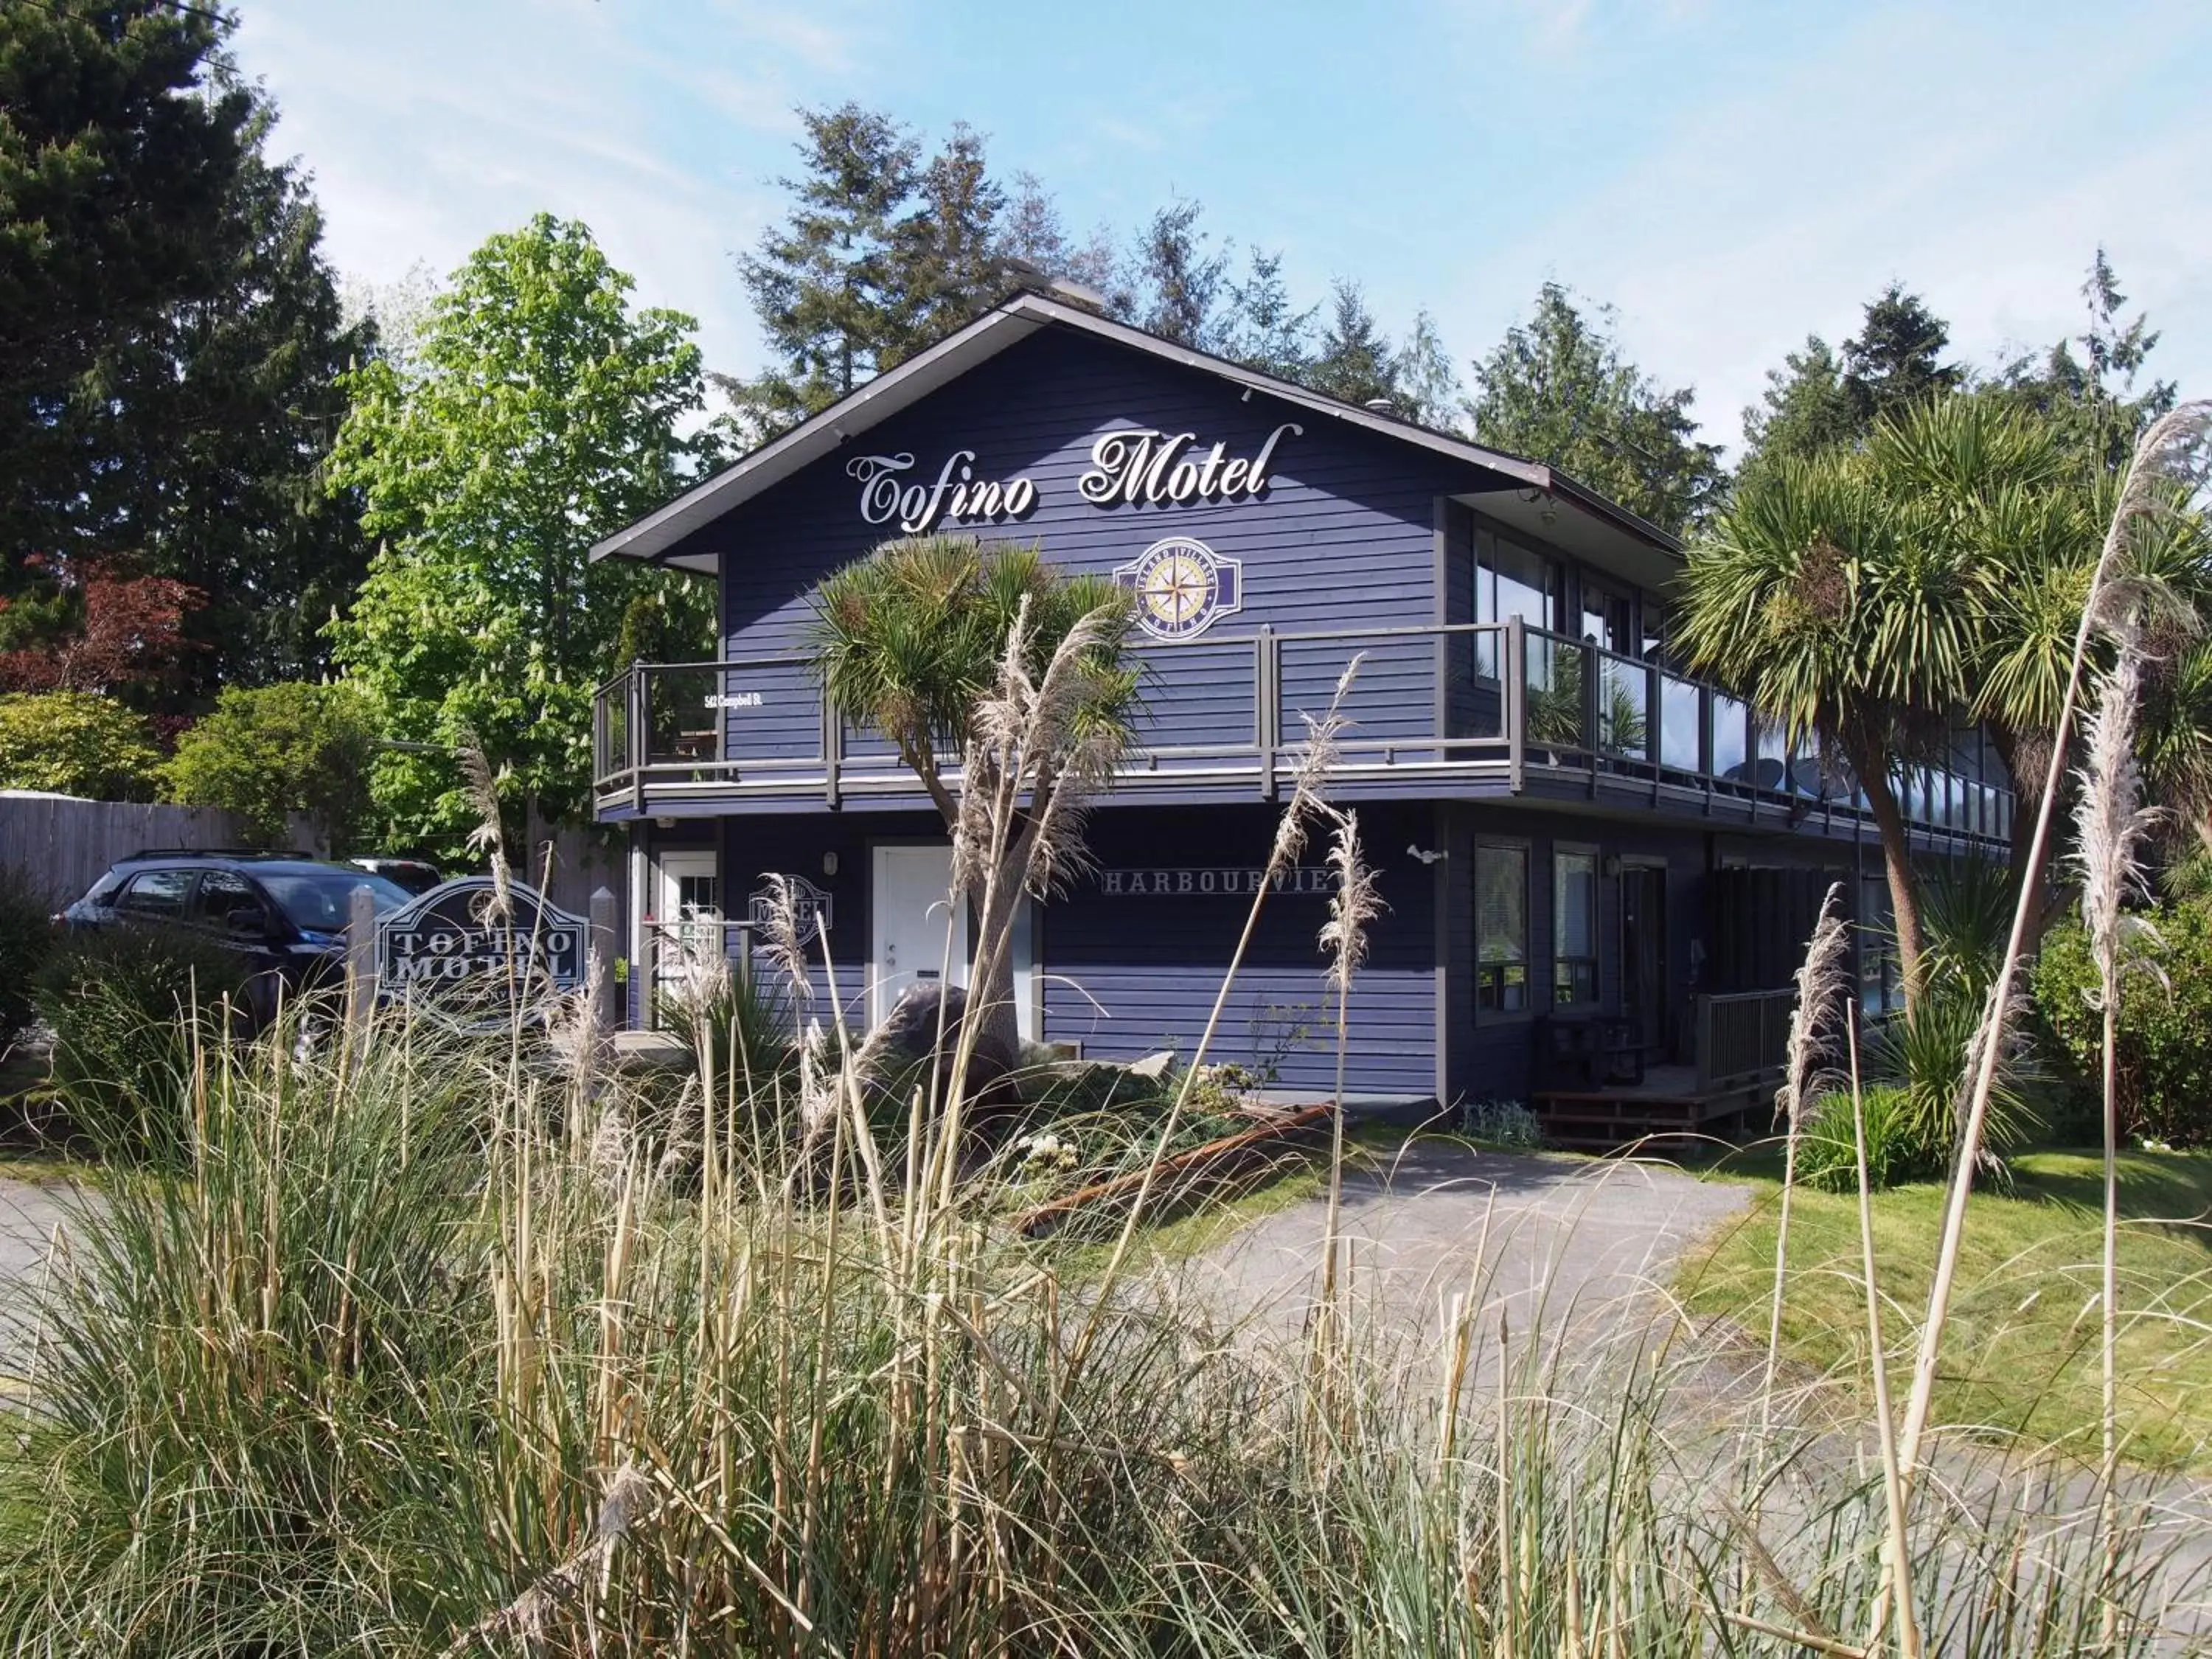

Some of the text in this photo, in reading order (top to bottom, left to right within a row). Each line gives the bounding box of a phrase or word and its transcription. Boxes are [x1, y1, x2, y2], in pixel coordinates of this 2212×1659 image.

[846, 424, 1304, 532] Tofino Motel
[1138, 547, 1214, 588] ISLAND VILLAGE
[718, 692, 751, 709] Campbell
[1106, 869, 1348, 893] HARBOURVIE
[757, 900, 824, 922] MEL
[394, 933, 571, 956] TOFINO
